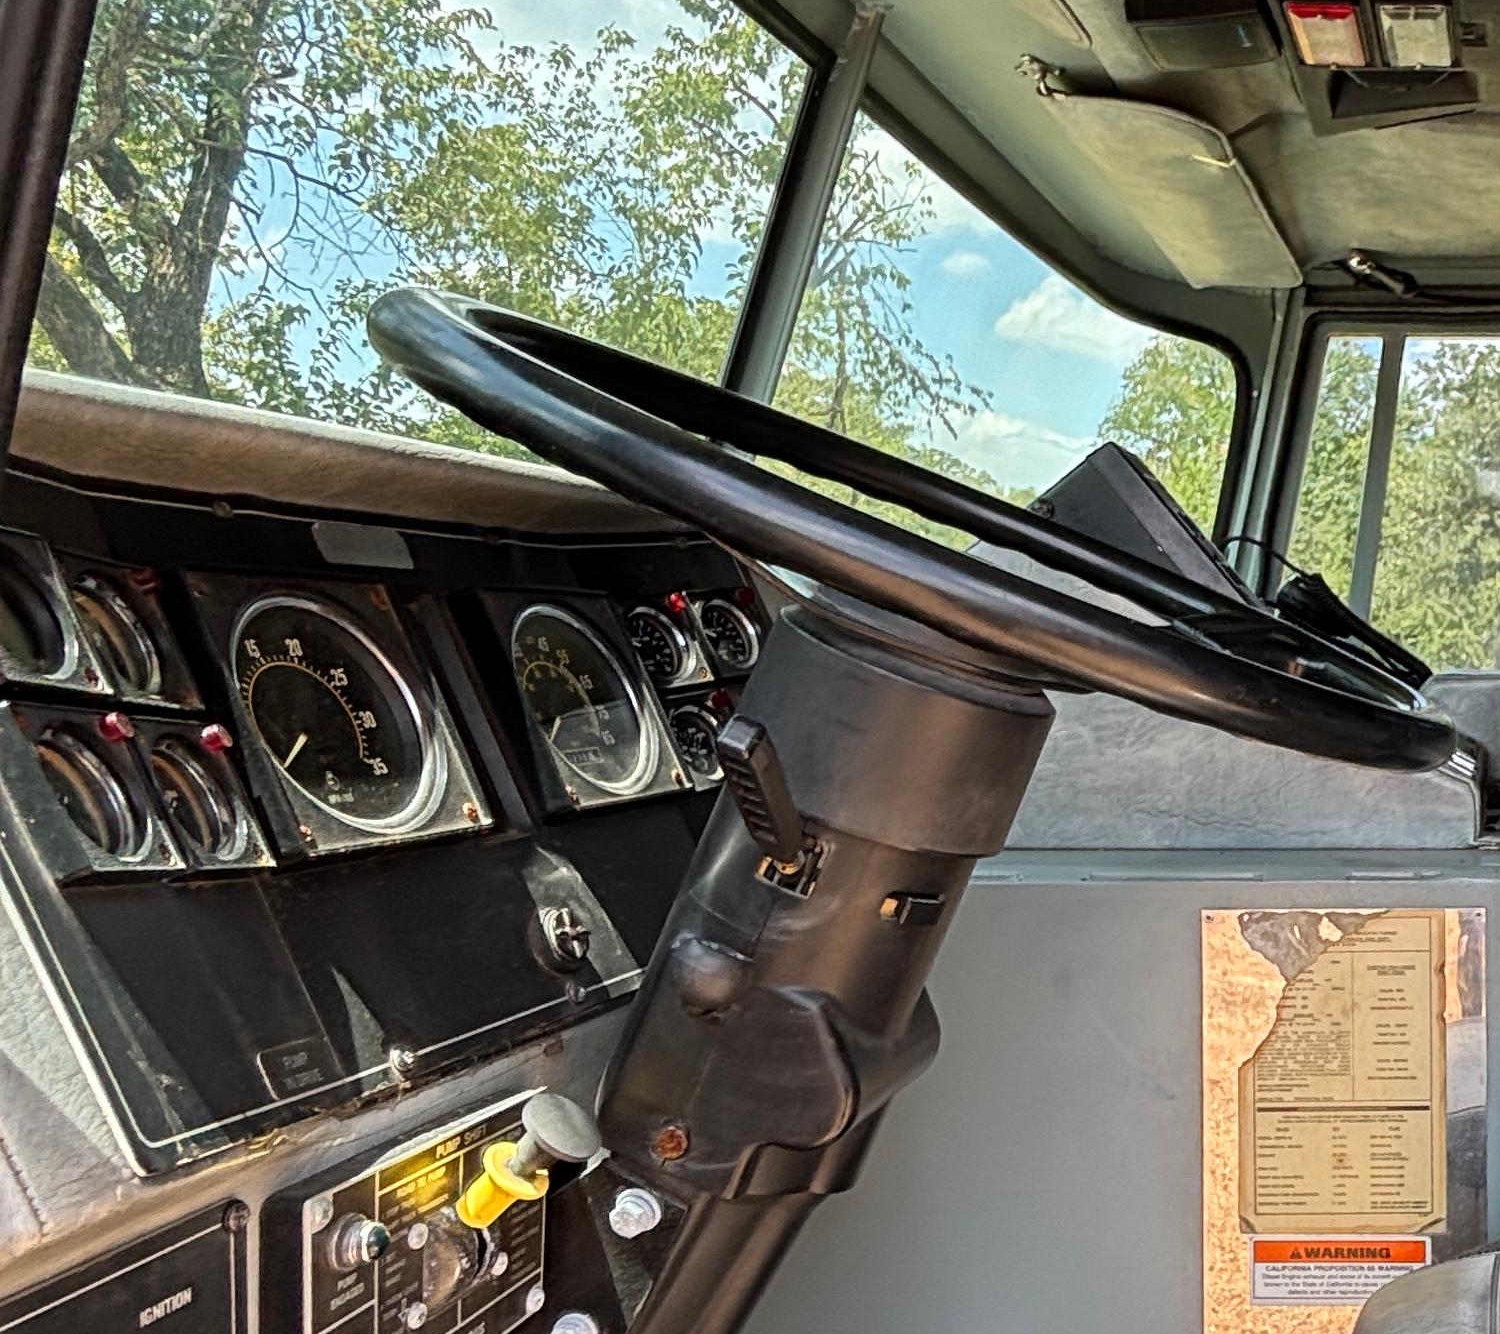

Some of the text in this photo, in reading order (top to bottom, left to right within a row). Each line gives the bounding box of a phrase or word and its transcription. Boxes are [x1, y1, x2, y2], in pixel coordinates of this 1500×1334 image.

[244, 638, 261, 659] 15
[284, 638, 303, 657] 20
[330, 667, 348, 687] 25
[359, 710, 377, 729] 30
[372, 757, 389, 776] 35
[435, 1136, 461, 1159] PUMP
[464, 1124, 487, 1145] SHIFT
[1304, 1246, 1392, 1259] WARNING
[139, 1286, 193, 1328] IGNITION
